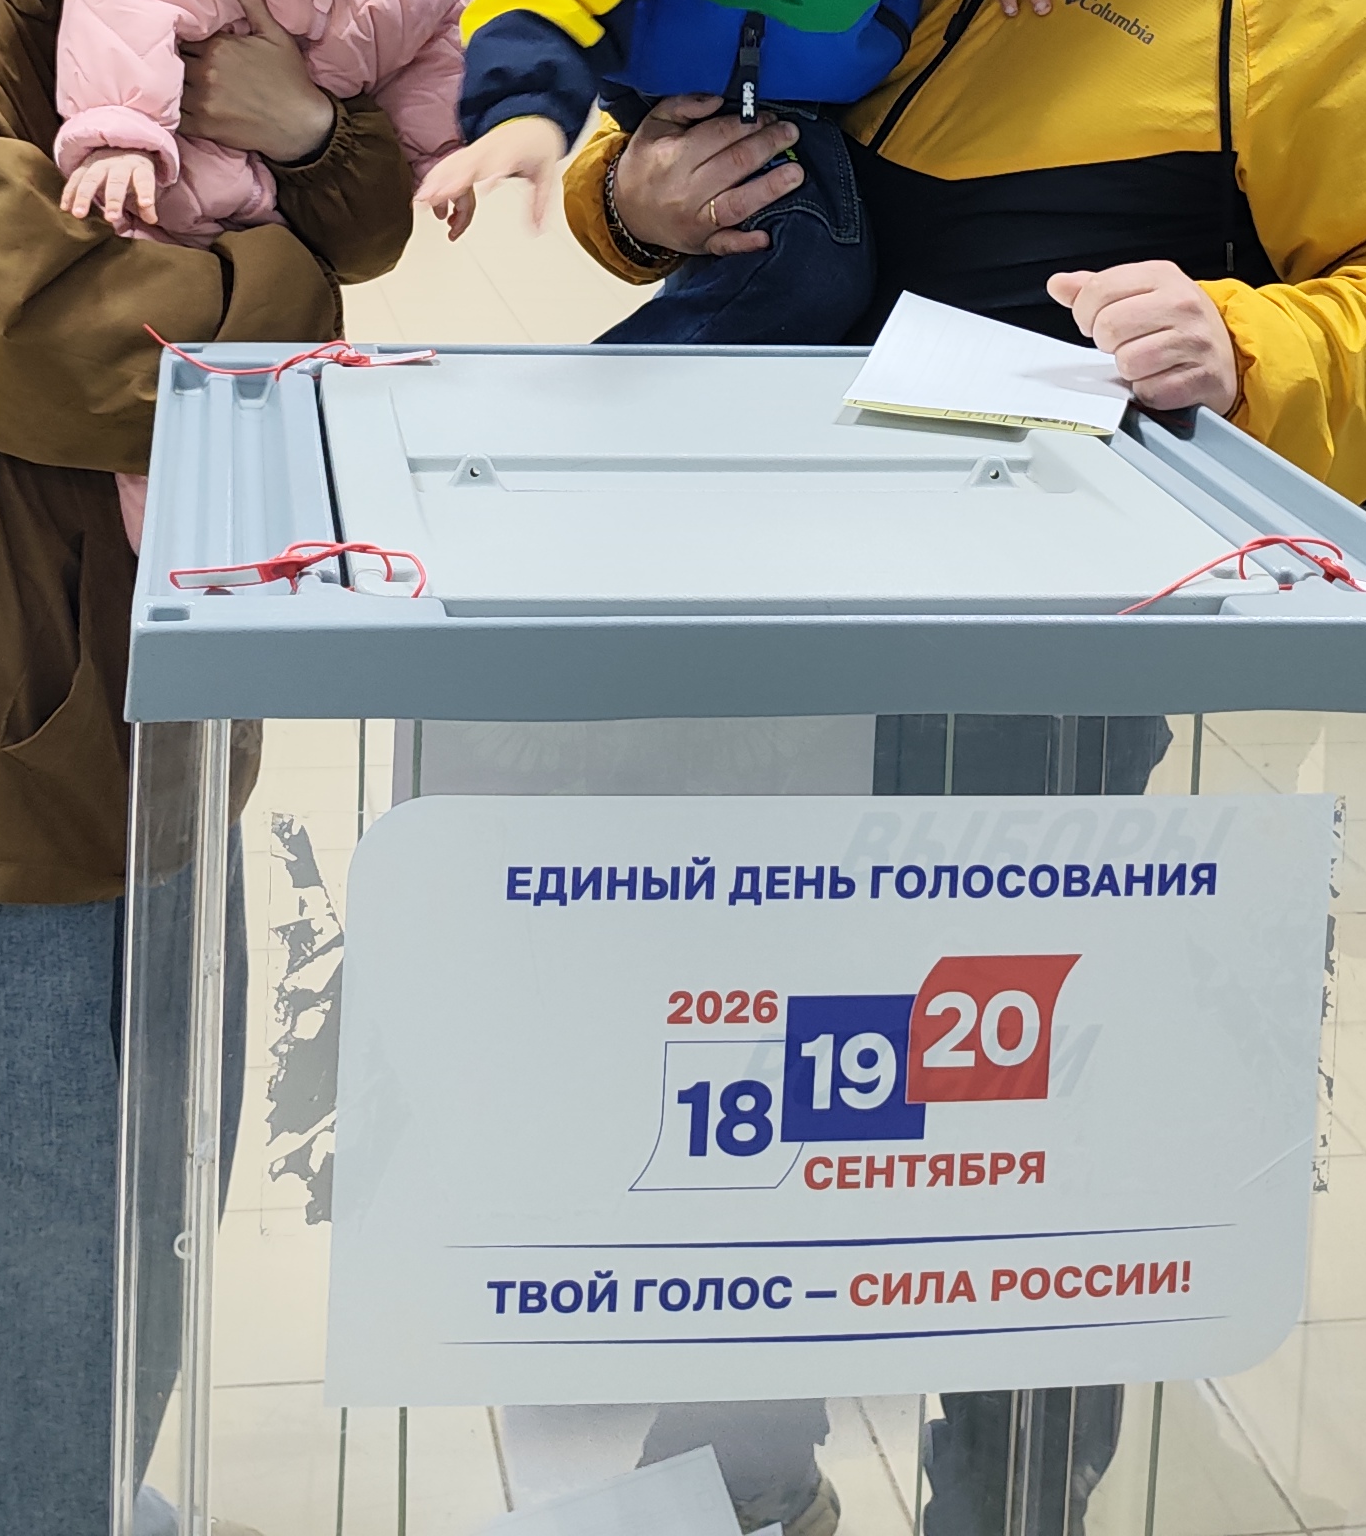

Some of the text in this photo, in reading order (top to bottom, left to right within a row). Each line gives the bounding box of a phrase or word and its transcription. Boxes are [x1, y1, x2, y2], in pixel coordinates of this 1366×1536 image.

[742, 81, 755, 118] GAME
[506, 856, 1218, 907] ЕДИНЫЙ ДЕНЬ ГОЛОСОВАНИЯ
[666, 990, 779, 1025] 2026
[922, 989, 1041, 1068] 20
[800, 1032, 897, 1111] 19
[677, 1080, 774, 1157] 18
[803, 1150, 1047, 1191] СЕНТЯБРЯ
[487, 1270, 619, 1314] ТВОЙ
[634, 1275, 793, 1312] ГОЛОС
[849, 1270, 977, 1308] СИЛА
[991, 1260, 1193, 1302] РОССИИ!
